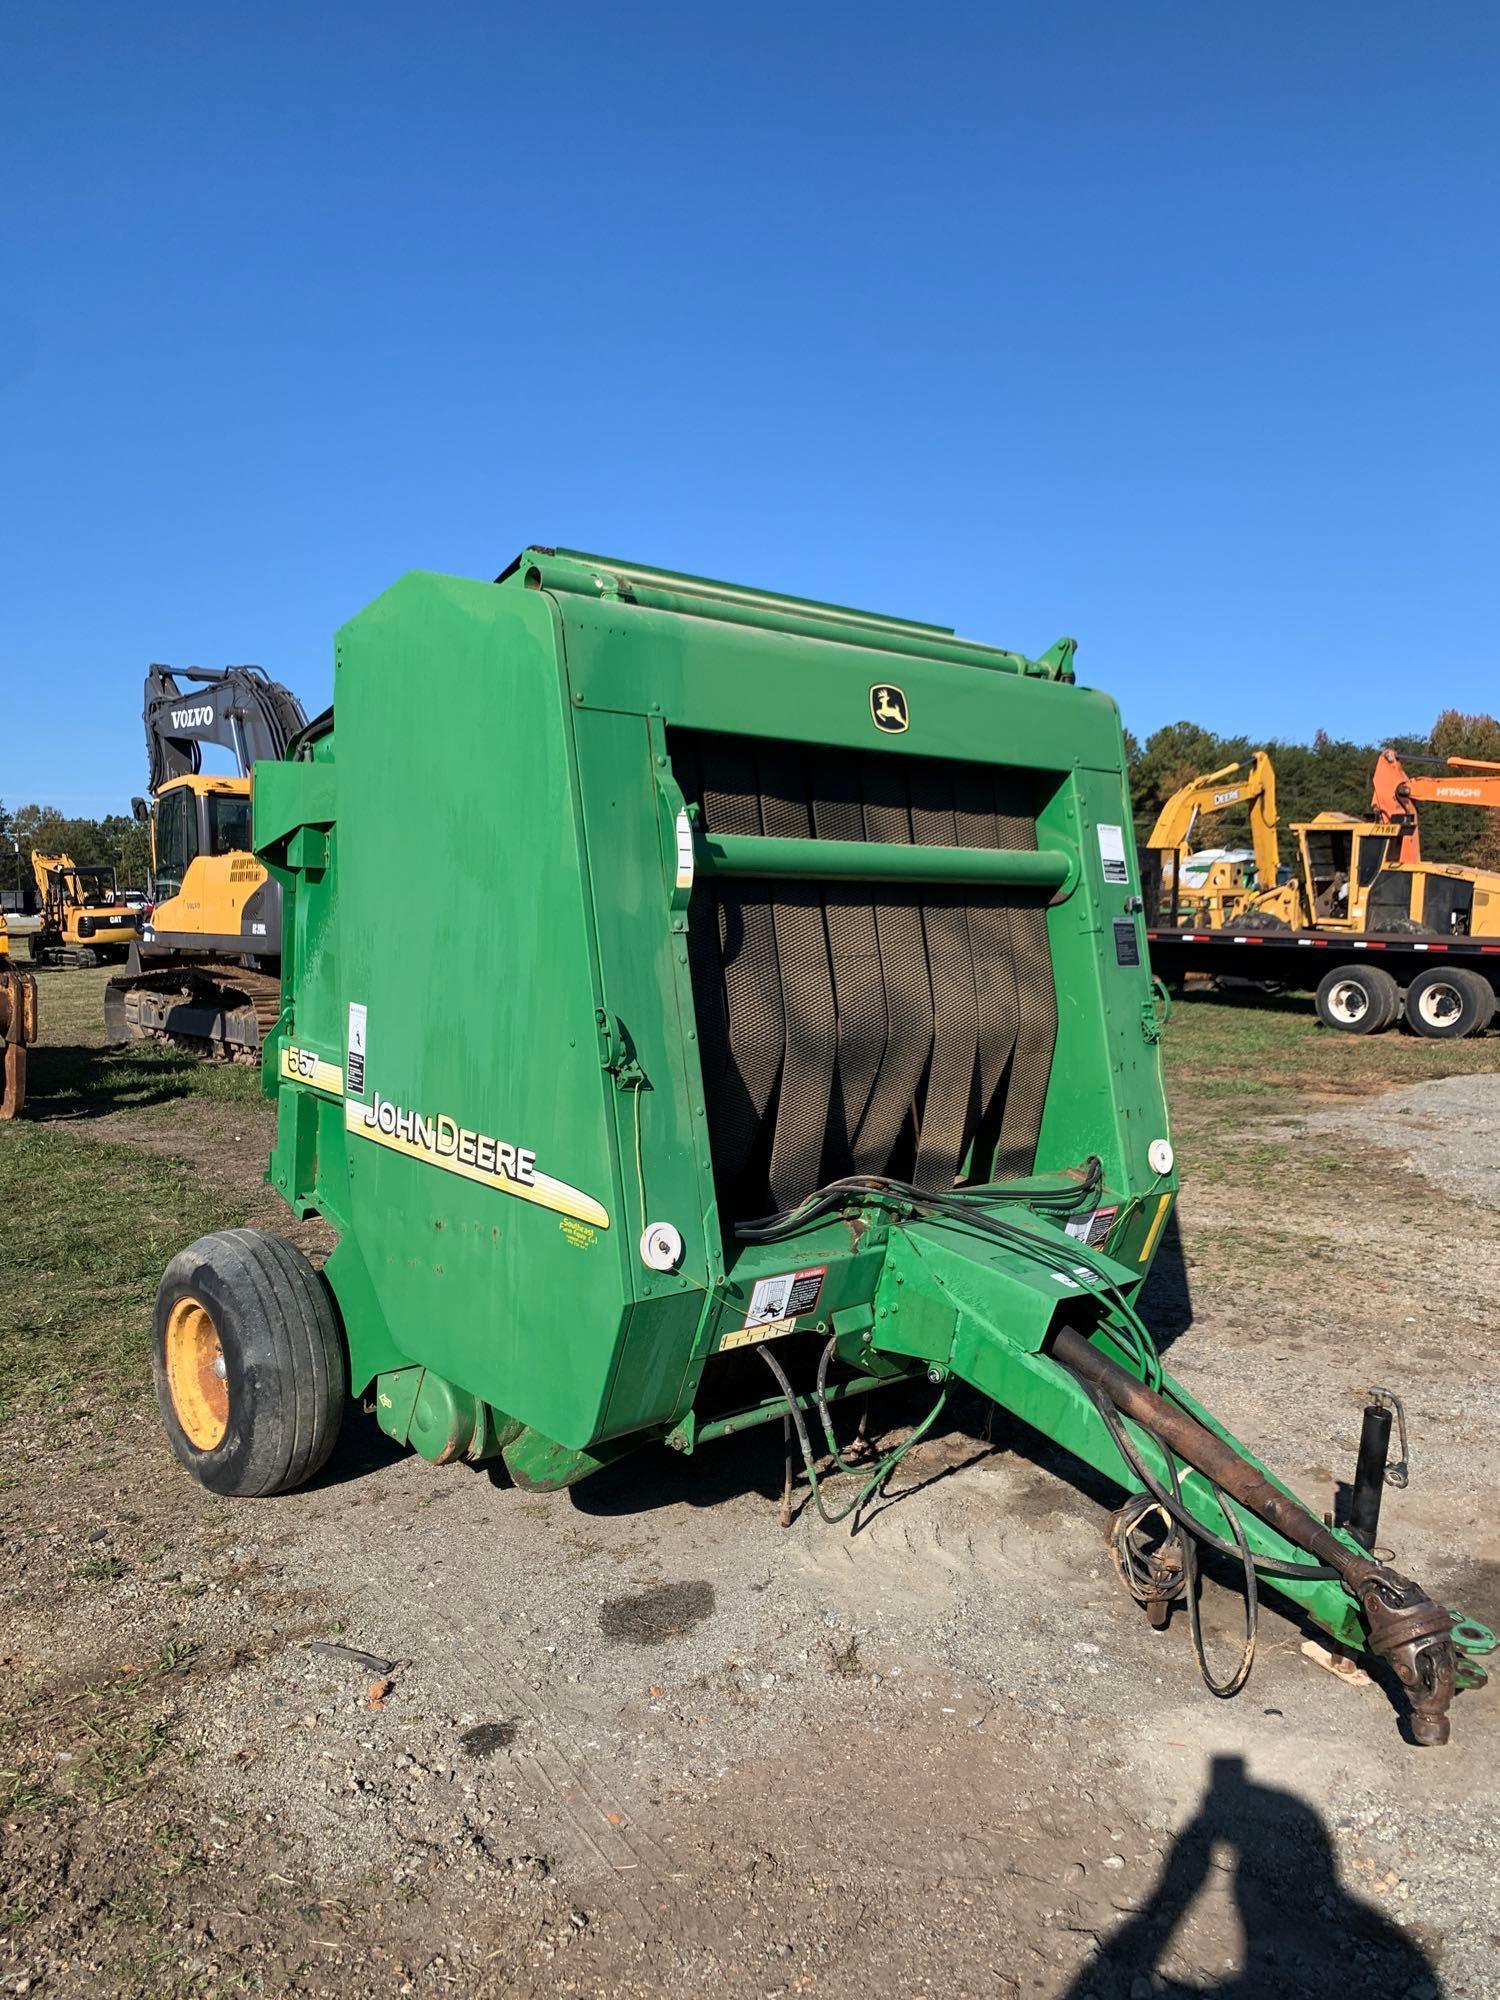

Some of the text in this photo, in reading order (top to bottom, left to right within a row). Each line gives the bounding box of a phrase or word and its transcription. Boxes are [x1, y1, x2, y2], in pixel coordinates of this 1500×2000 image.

[171, 705, 213, 729] VOLVO
[1214, 790, 1239, 805] DEERE
[1436, 787, 1481, 798] HITACHI
[109, 916, 122, 924] CAT
[288, 1045, 319, 1079] 557
[364, 1091, 536, 1187] JOHN DEERE
